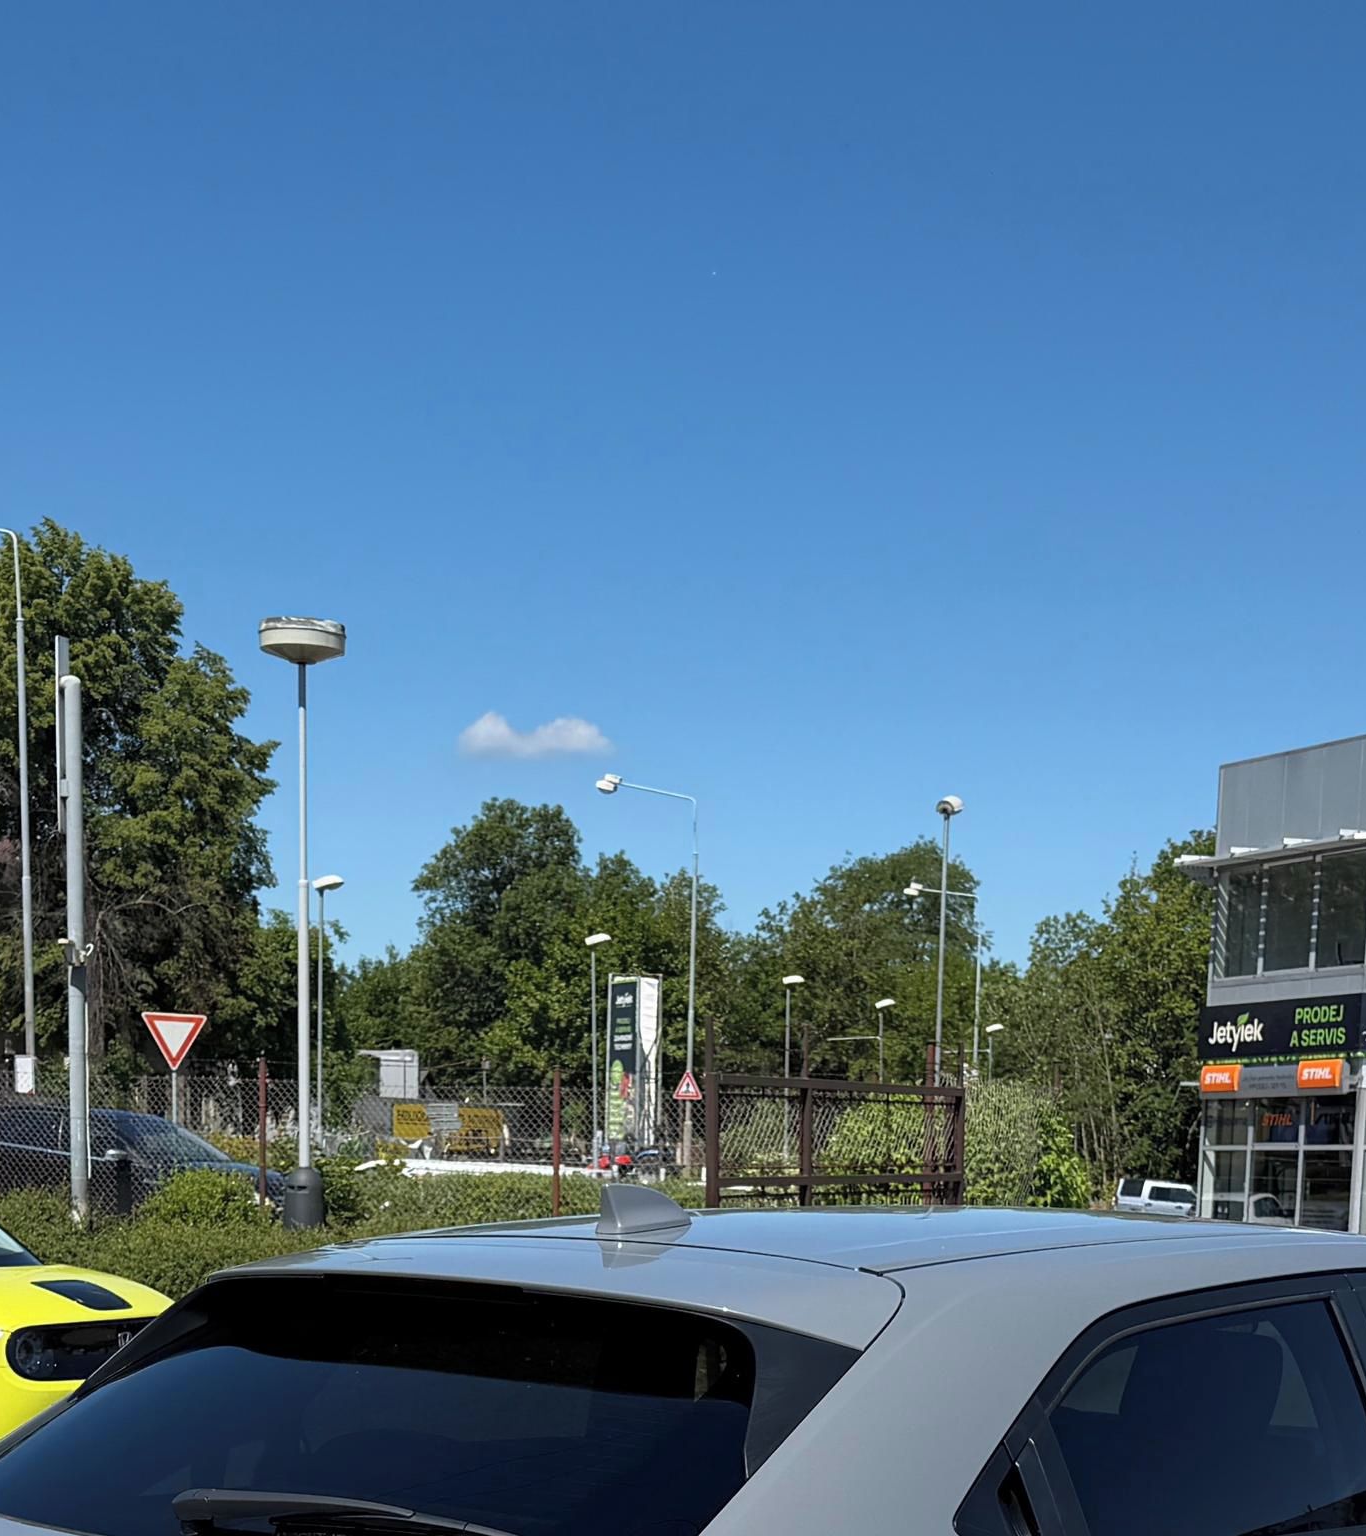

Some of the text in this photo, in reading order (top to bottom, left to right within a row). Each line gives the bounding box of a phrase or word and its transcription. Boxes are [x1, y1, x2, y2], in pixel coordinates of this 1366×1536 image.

[1294, 1004, 1345, 1025] PRODEJ
[1289, 1028, 1346, 1048] A SERVIS
[1204, 1072, 1232, 1085] STIHL
[1301, 1067, 1333, 1081] STIHL
[1262, 1113, 1293, 1127] STIHL
